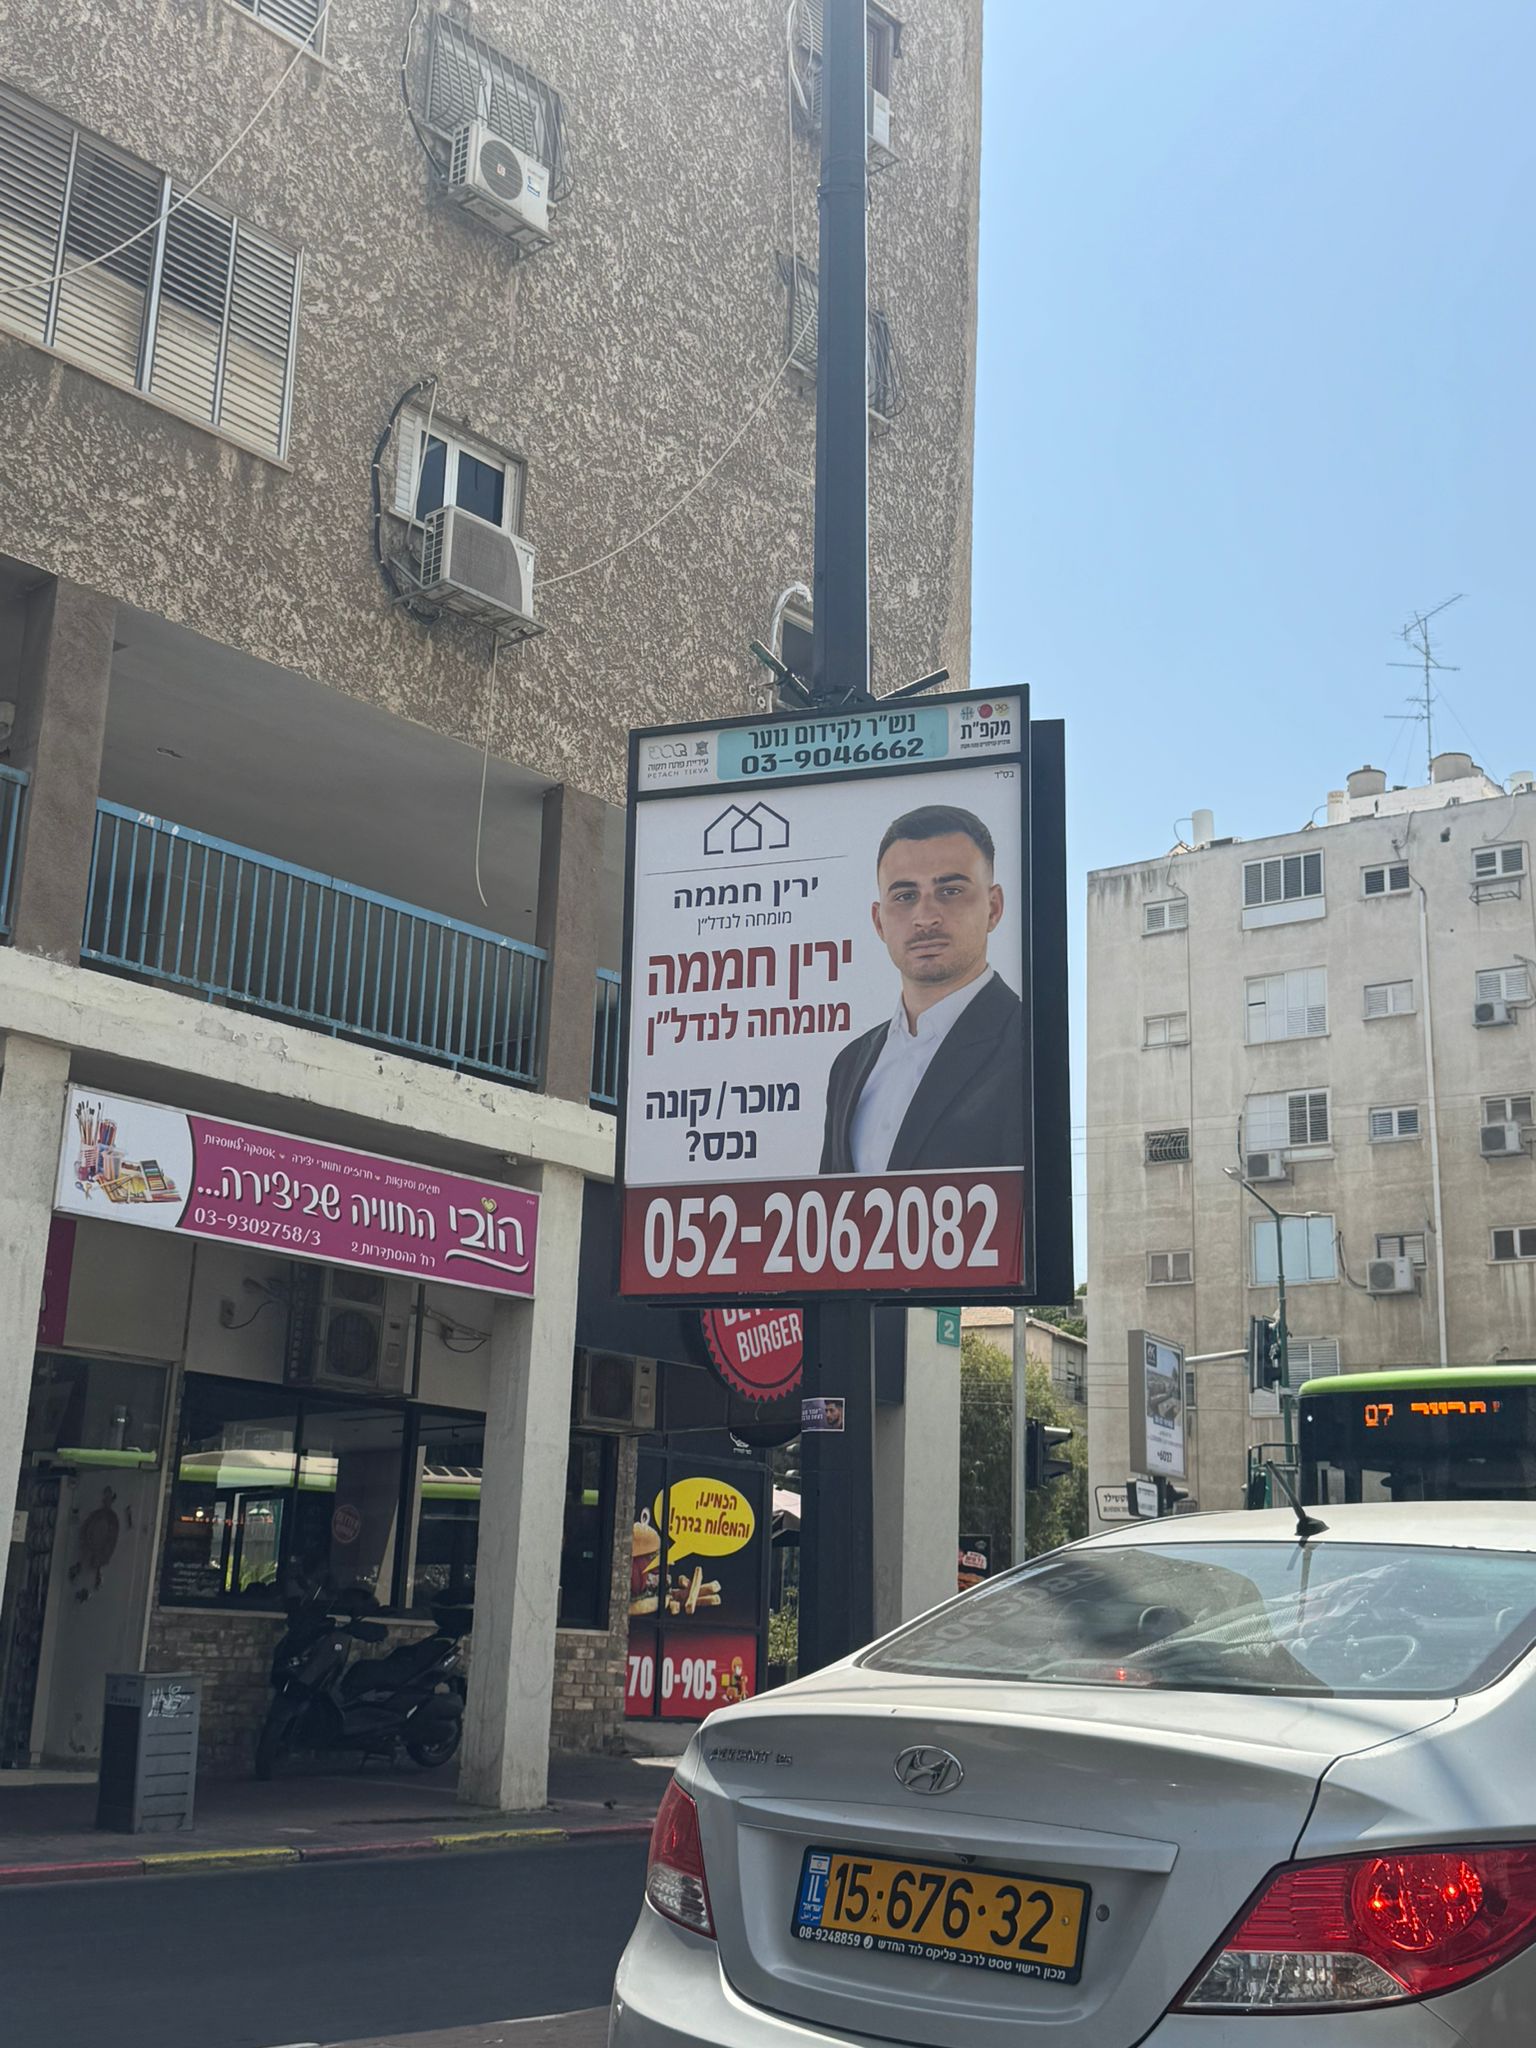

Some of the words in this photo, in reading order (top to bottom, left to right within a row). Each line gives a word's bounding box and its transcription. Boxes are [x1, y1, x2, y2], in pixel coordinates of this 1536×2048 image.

[747, 728, 788, 750] נוער
[795, 717, 862, 746] לקידום
[741, 737, 924, 775] 03-9046662
[647, 770, 679, 779] PETACH
[684, 767, 709, 776] TIKVA
[673, 882, 762, 909] חממה
[773, 876, 819, 907] ירין
[745, 910, 792, 928] מומחה
[648, 945, 776, 996] חממה
[788, 939, 853, 1001] ירין
[747, 1002, 851, 1038] מומחה
[685, 1129, 757, 1162] נכס?
[194, 1207, 321, 1246] 03-9302758/3
[350, 1193, 437, 1241] החוויה
[643, 1183, 999, 1279] 052-2062082
[351, 1241, 359, 1253] 2
[359, 1243, 417, 1264] ההסתדרות
[736, 1312, 803, 1363] BURGER
[943, 1319, 955, 1340] 2
[669, 1507, 702, 1535] בדרך!
[704, 1511, 751, 1539] והמשלוח
[807, 1874, 821, 1903] IL
[799, 1925, 861, 1948] 08-9248859
[877, 1938, 905, 1953] החדש
[908, 1943, 923, 1956] לוד
[925, 1947, 957, 1961] פליקס
[958, 1953, 985, 1967] לרכב
[987, 1958, 1012, 1972] טסט
[1015, 1962, 1041, 1976] רישוי
[1043, 1967, 1067, 1981] מכון
